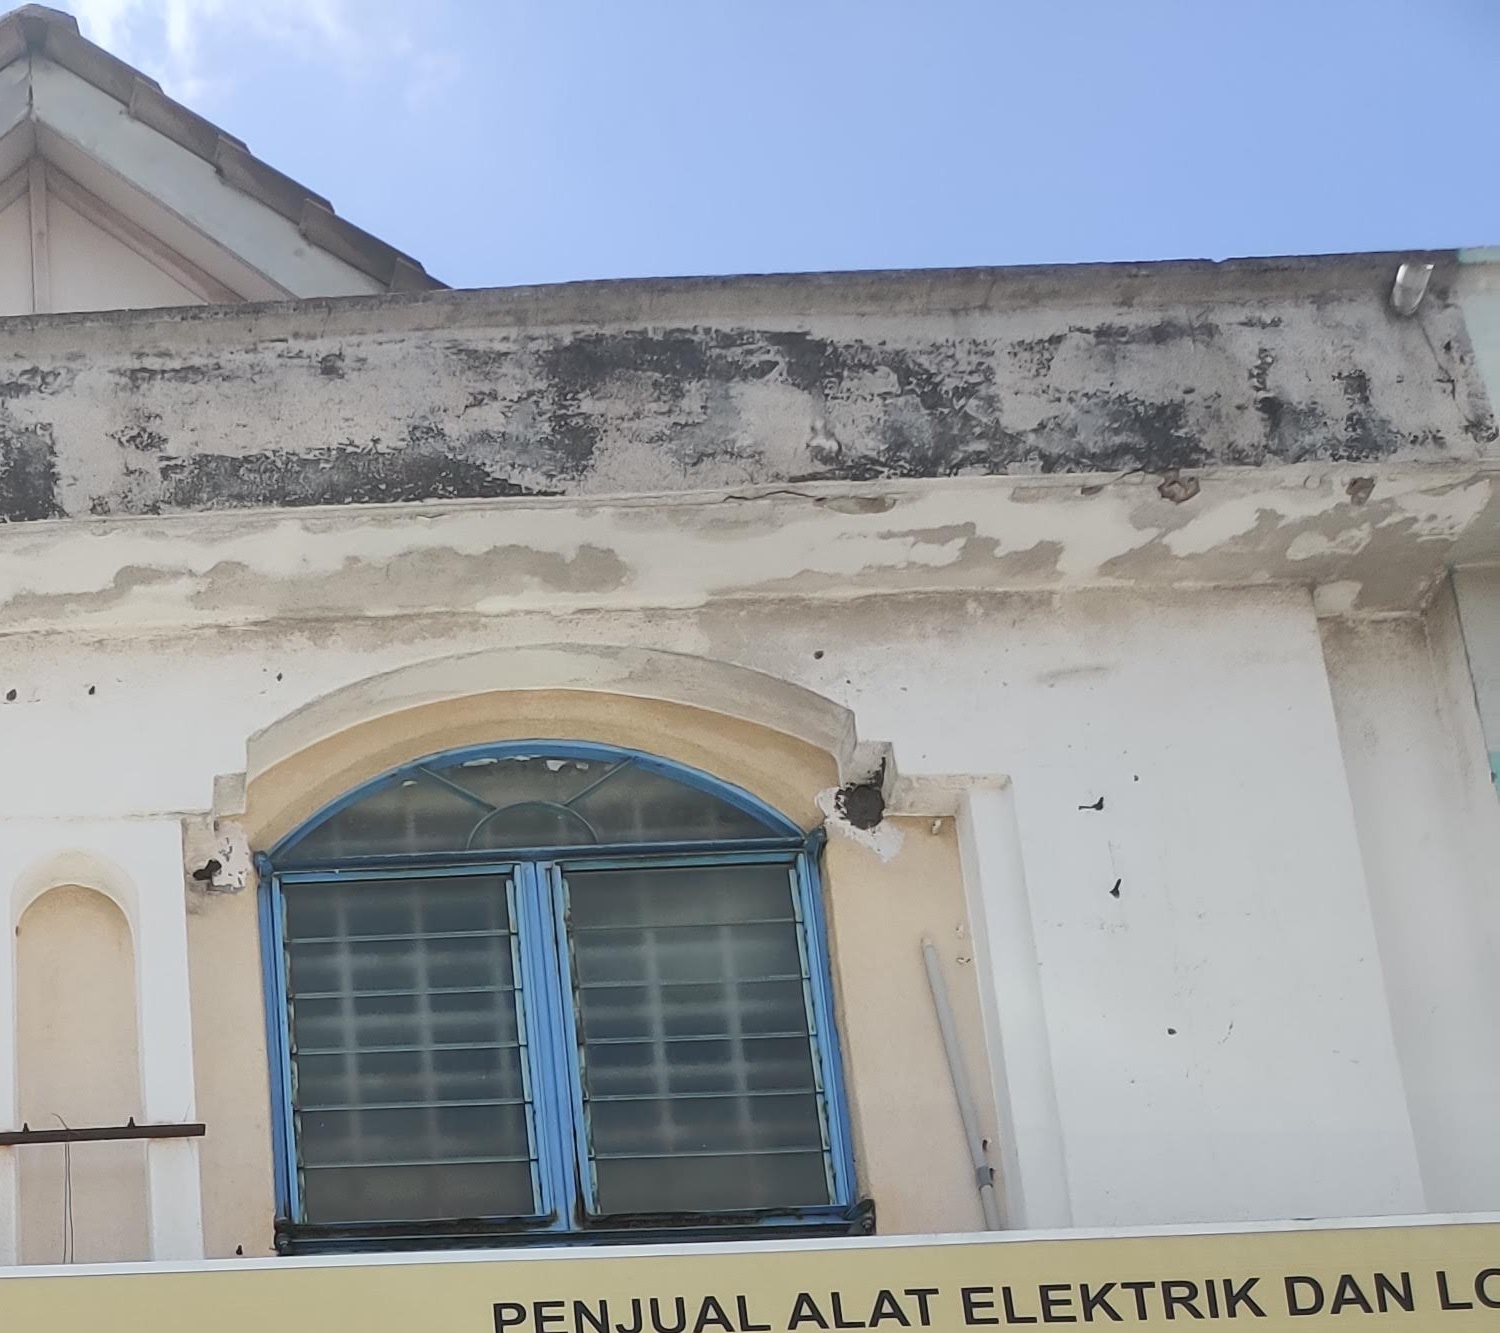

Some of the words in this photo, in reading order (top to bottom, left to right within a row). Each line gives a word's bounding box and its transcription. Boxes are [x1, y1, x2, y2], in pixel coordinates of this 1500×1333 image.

[787, 1288, 940, 1331] ALAT
[960, 1277, 1267, 1326] ELEKTRIK
[1284, 1272, 1415, 1316] DAN
